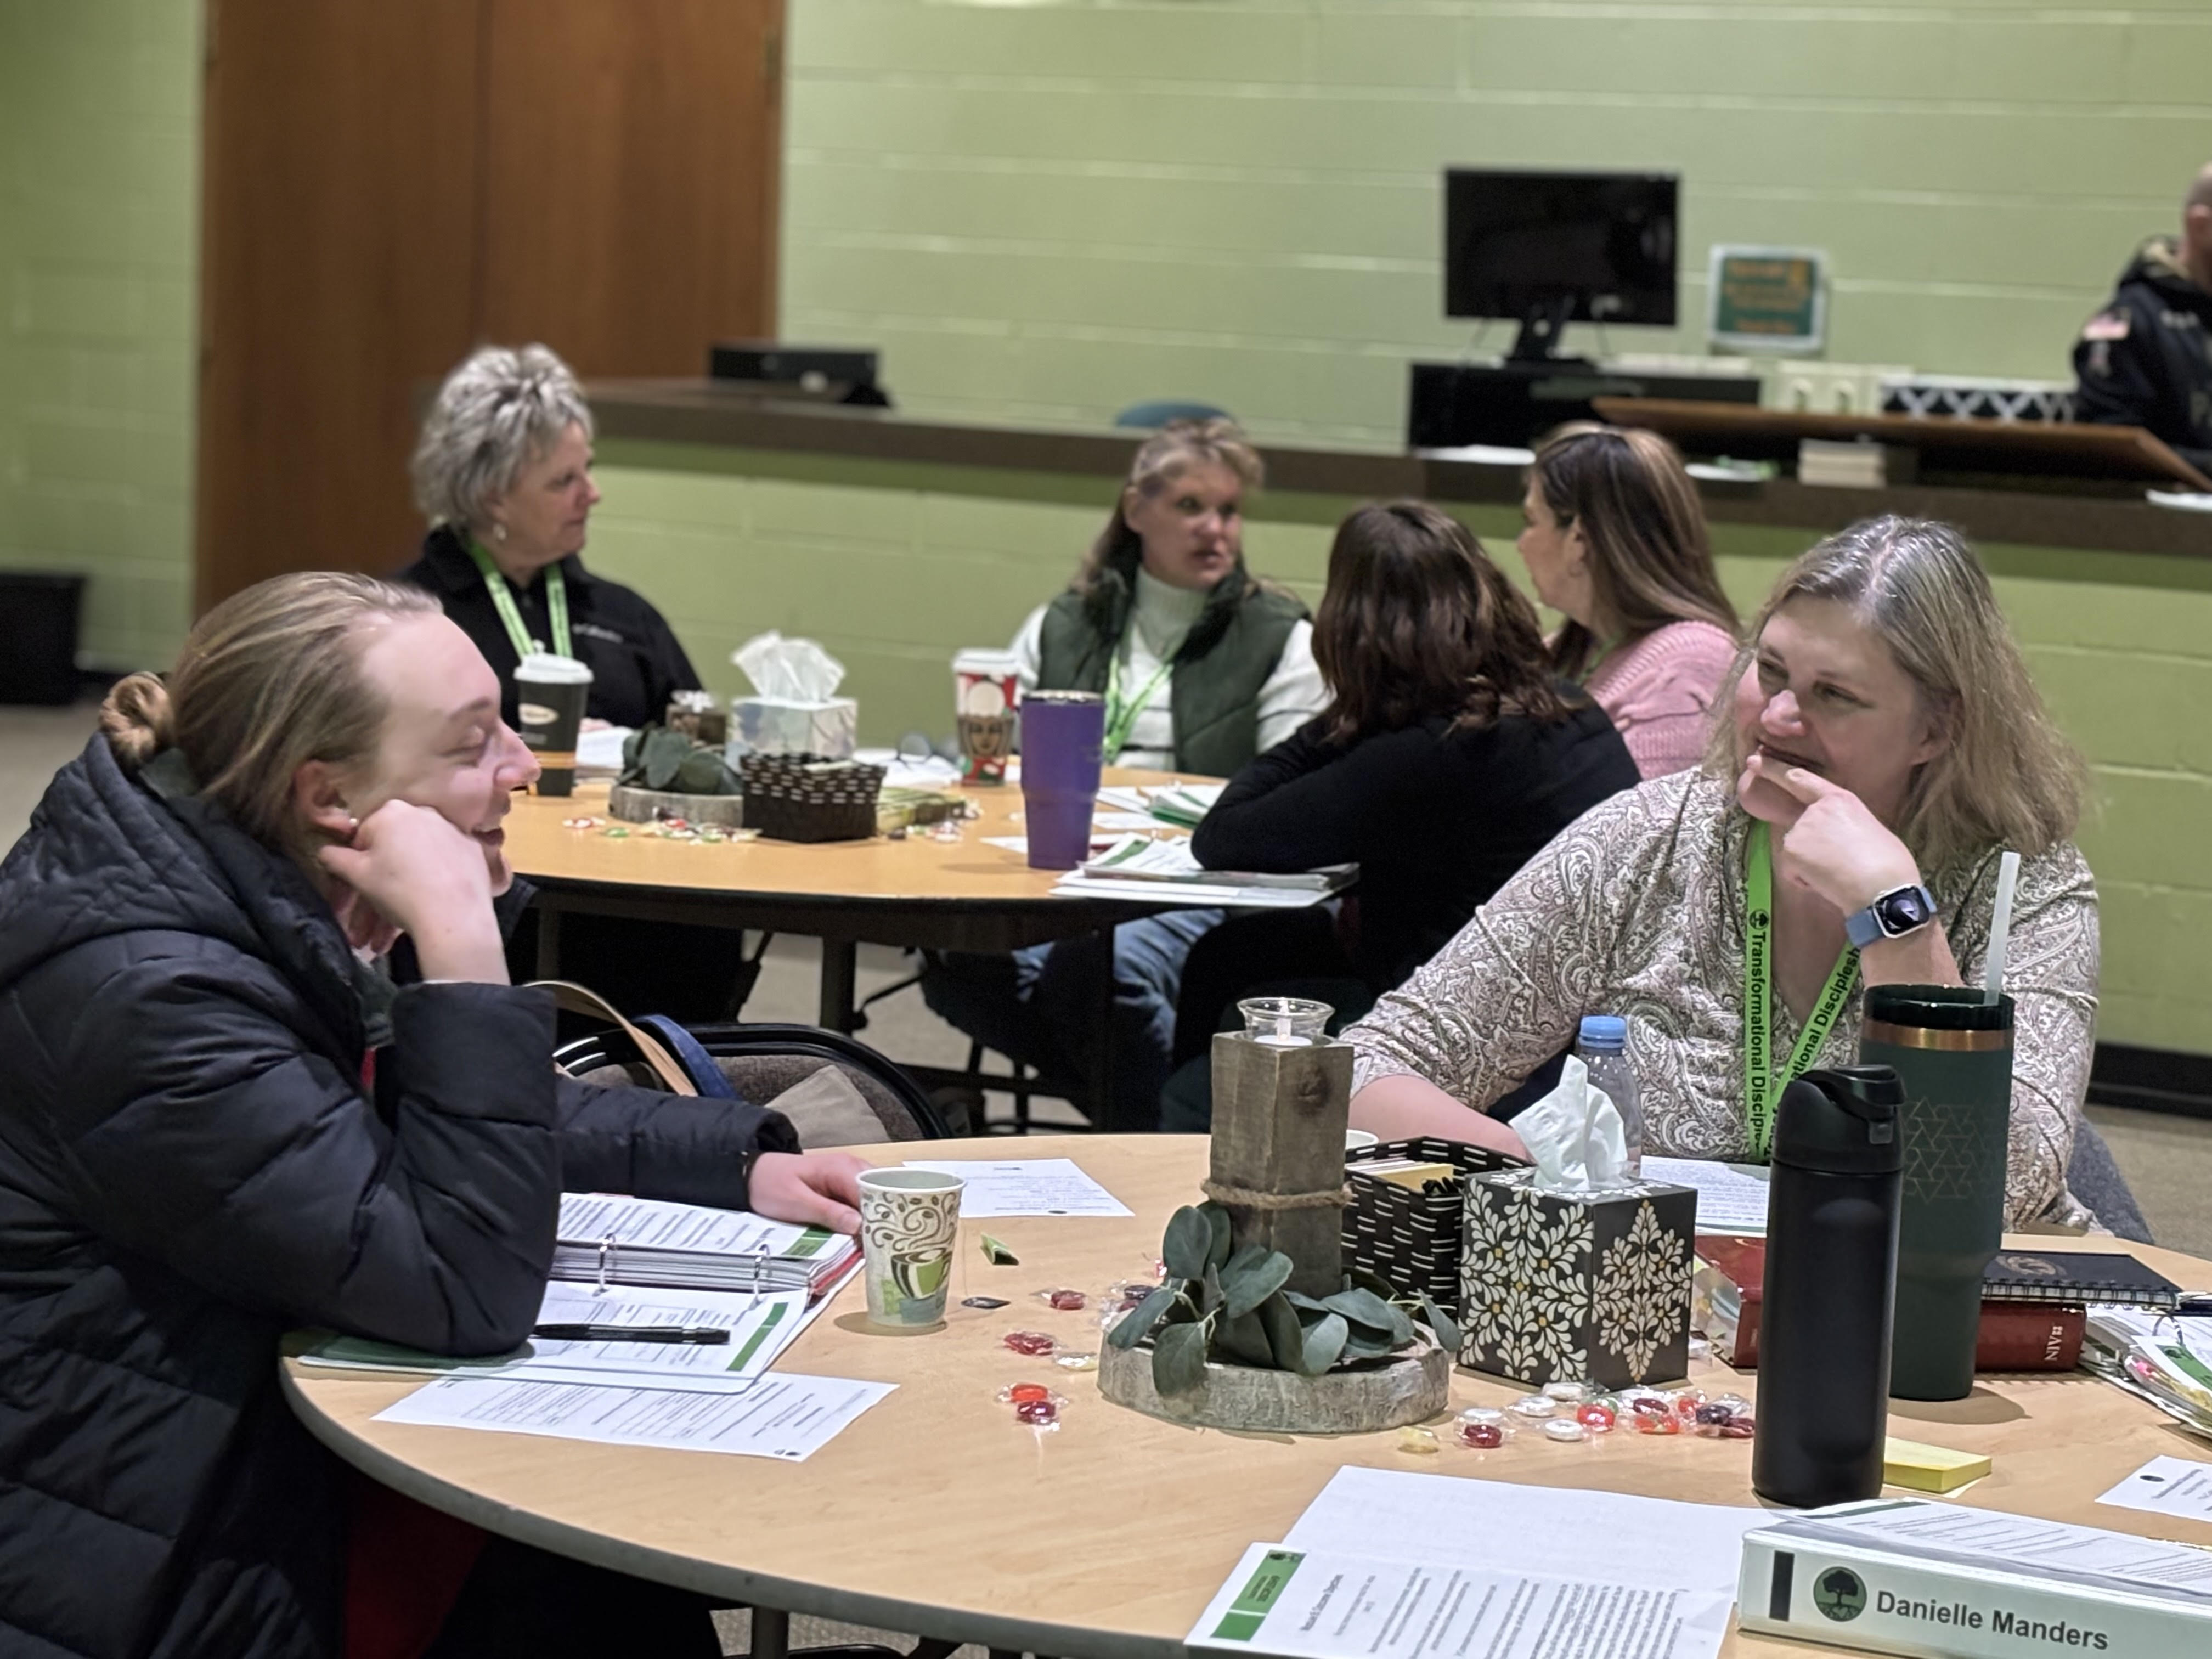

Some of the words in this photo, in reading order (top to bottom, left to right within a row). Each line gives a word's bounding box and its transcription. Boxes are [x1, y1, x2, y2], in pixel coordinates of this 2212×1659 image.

[1750, 931, 1766, 1070] Transformational
[1814, 947, 1860, 1028] Disciplesh
[2044, 1335, 2062, 1361] NIV
[1877, 1590, 1983, 1629] Danielle
[1992, 1610, 2109, 1650] Manders
